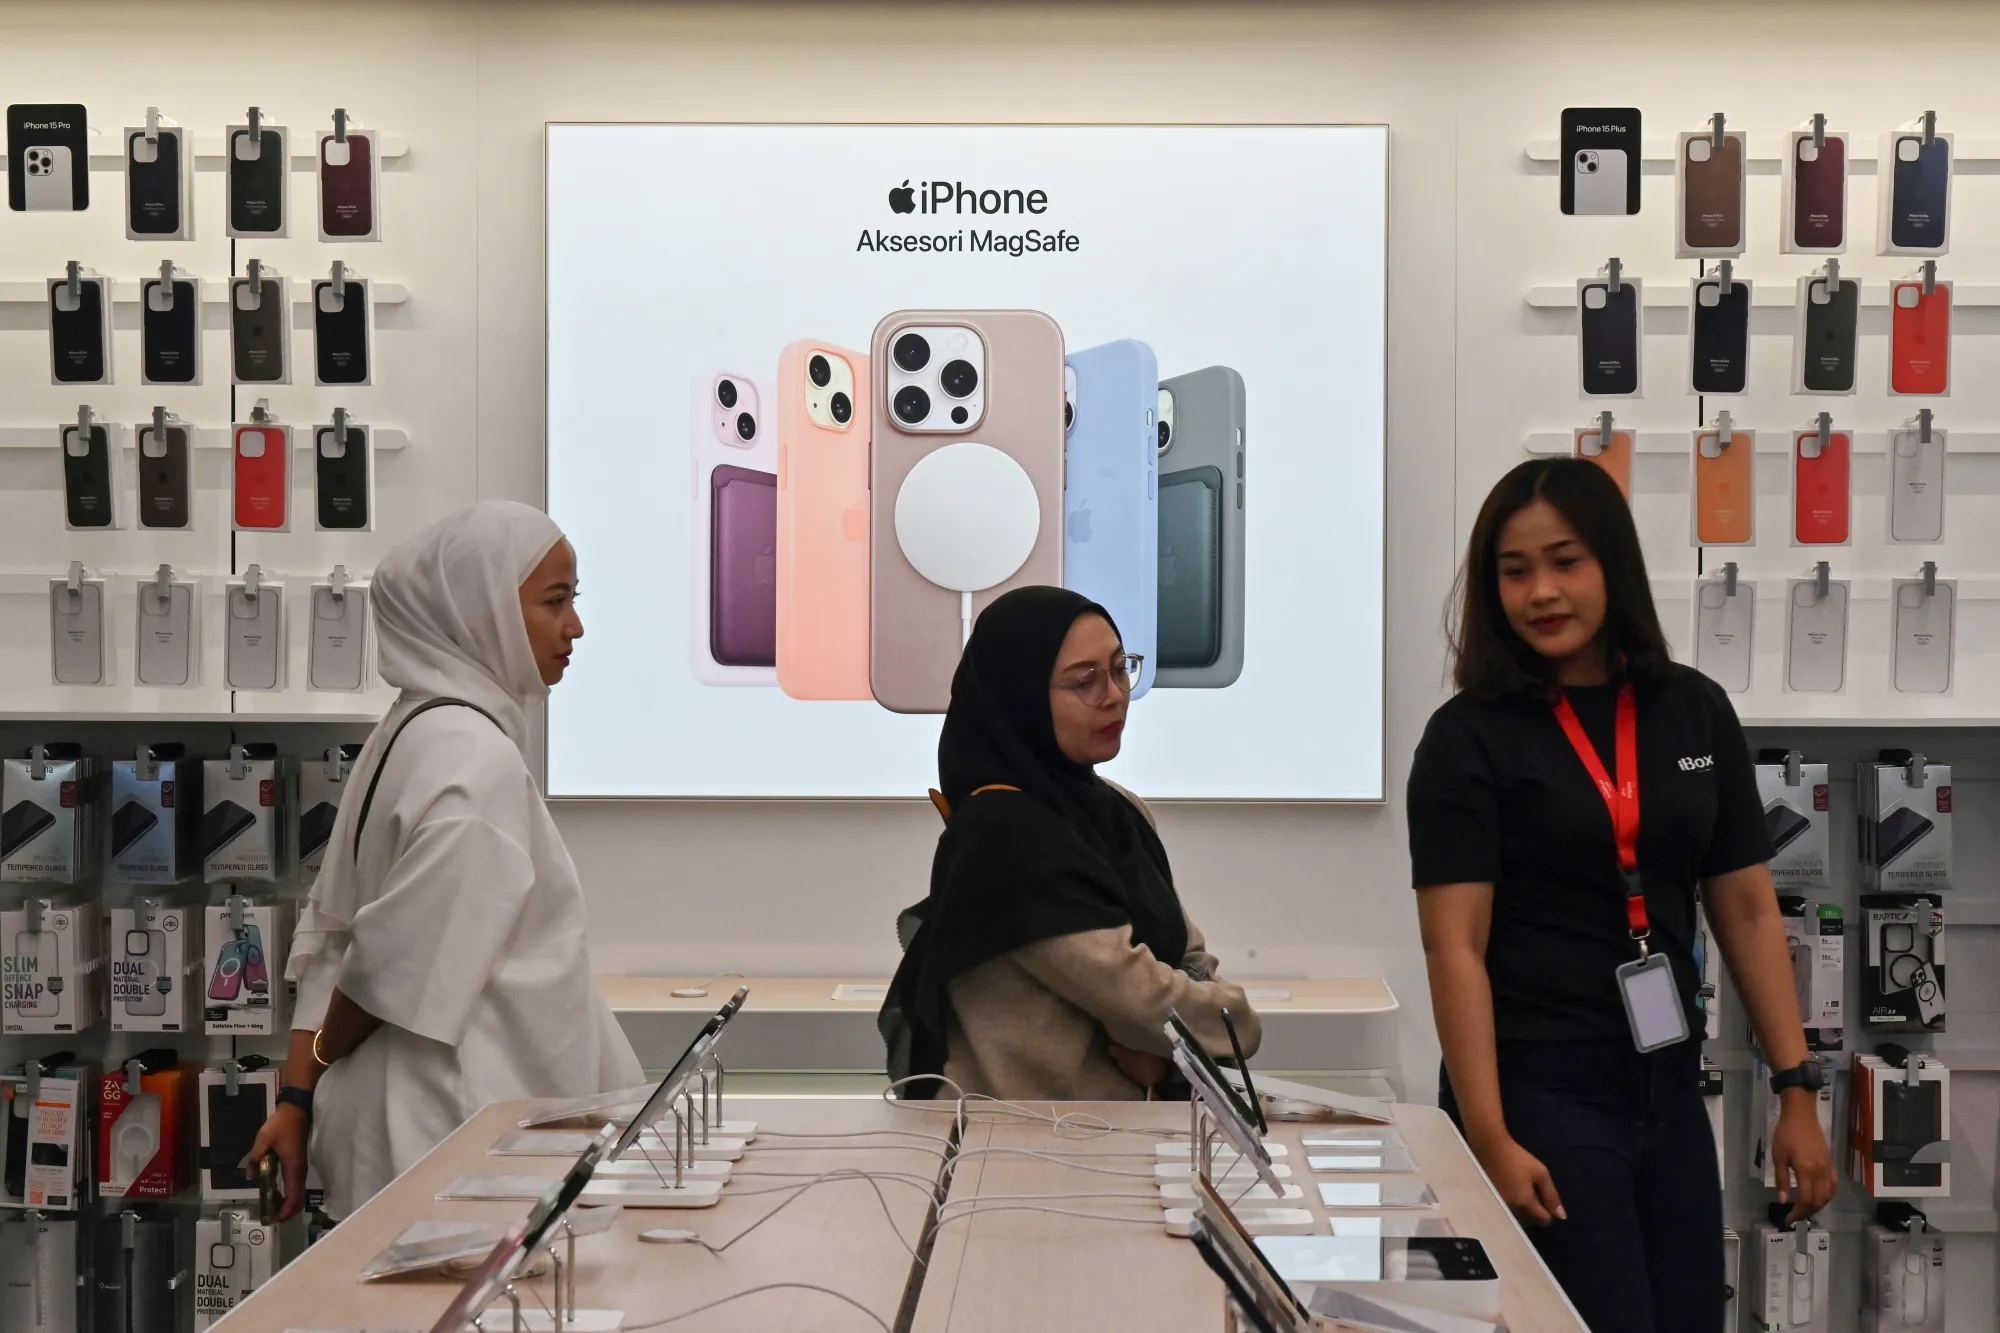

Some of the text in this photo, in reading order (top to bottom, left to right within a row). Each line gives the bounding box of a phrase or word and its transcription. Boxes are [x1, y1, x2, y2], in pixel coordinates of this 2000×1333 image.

[24, 121, 70, 129] iPhone 15 Pro
[1576, 125, 1626, 133] iPhone 15 Plus
[921, 181, 1048, 214] iPhone
[856, 229, 1080, 257] Aksesori MagSafe
[1677, 754, 1714, 771] iBox
[1873, 912, 1905, 921] RAPTIC
[4, 956, 38, 973] SLIM
[113, 962, 145, 975] DUAL
[4, 974, 32, 982] DEFENCE
[4, 983, 44, 1000] SNAP
[113, 984, 150, 995] DOUBLE
[4, 1001, 38, 1009] CHARGING
[1872, 1006, 1888, 1014] AIR
[197, 1274, 229, 1288] DUAL
[197, 1297, 234, 1308] DOUBLE
